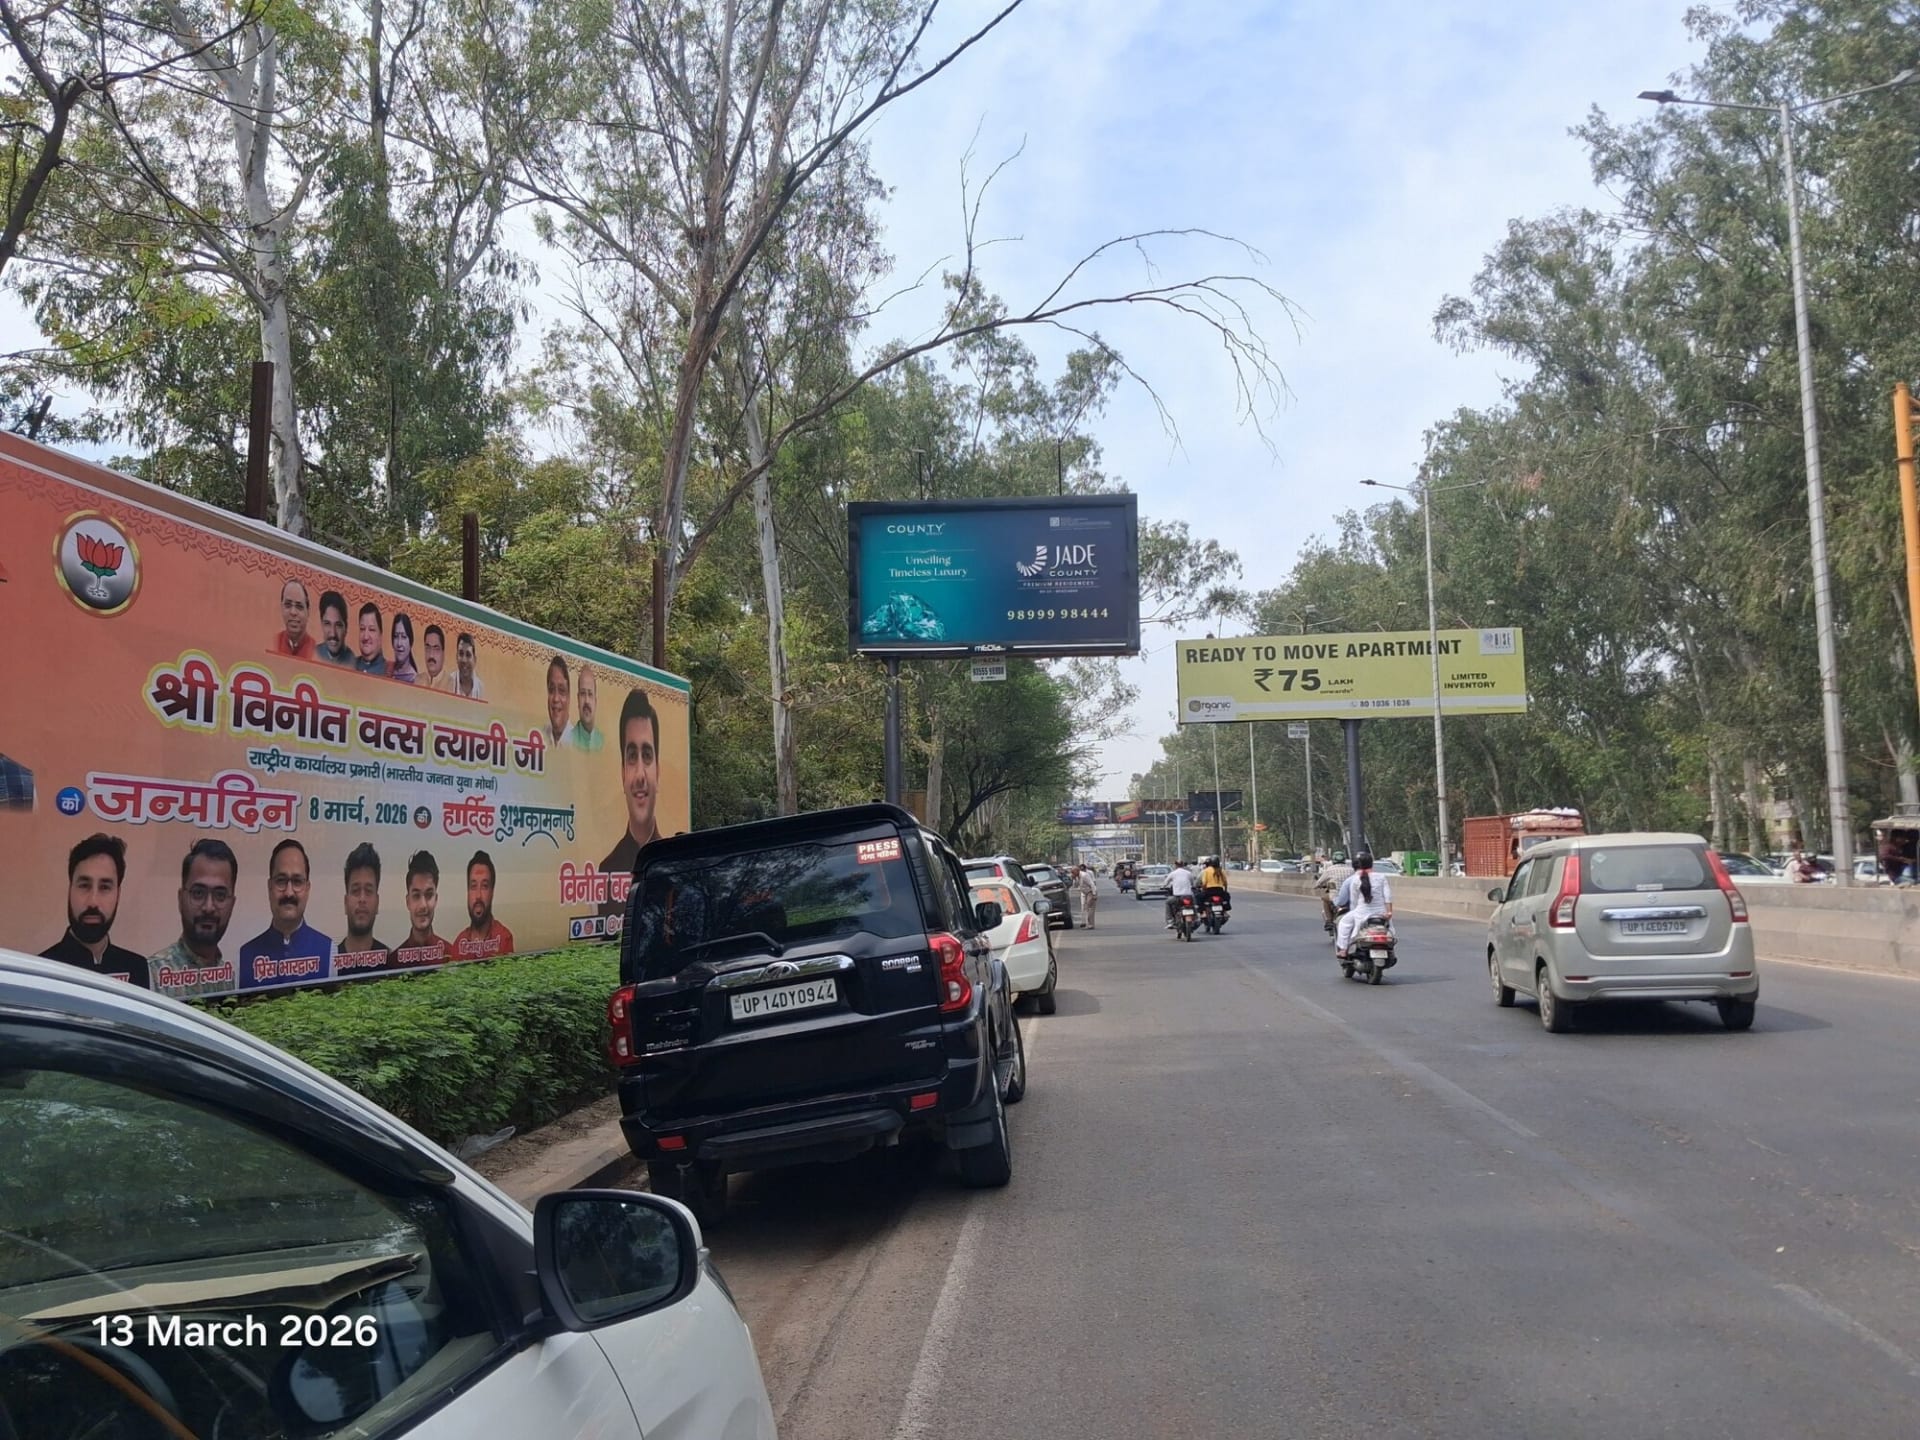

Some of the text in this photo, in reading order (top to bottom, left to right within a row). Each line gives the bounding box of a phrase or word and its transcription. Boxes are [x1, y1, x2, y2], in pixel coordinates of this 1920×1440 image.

[886, 524, 944, 534] COUNTY
[905, 554, 952, 567] Unveiling
[1049, 544, 1097, 569] JADE
[888, 567, 968, 578] Timeless Luxury
[1049, 569, 1098, 577] COUNTY
[1007, 607, 1109, 621] 98999 98444
[1186, 646, 1247, 664] READY
[1252, 645, 1276, 661] TO
[1284, 643, 1339, 660] MOVE
[1328, 678, 1354, 686] LAKH
[1444, 681, 1496, 689] INVENTORY
[1451, 672, 1488, 681] LIMITED
[151, 660, 546, 771] श्री विनीत वत्स त्यागी जी
[249, 748, 291, 773] राष्ट्रीय
[294, 754, 347, 775] कार्यालय
[349, 761, 380, 778] प्रभारी
[426, 771, 454, 786] जनता
[456, 776, 473, 793] युवा
[61, 793, 80, 812] को
[93, 774, 297, 828] जन्मदिन
[310, 797, 319, 820] 8
[324, 796, 369, 825] मार्च,
[375, 803, 408, 824] 2026
[442, 794, 496, 836] हार्दिक
[858, 840, 899, 853] PRESS
[559, 862, 609, 904] विनीत
[159, 961, 234, 988] निशंक त्यागी
[253, 956, 277, 982] प्रिंस
[741, 983, 835, 1014] UP14DY0944
